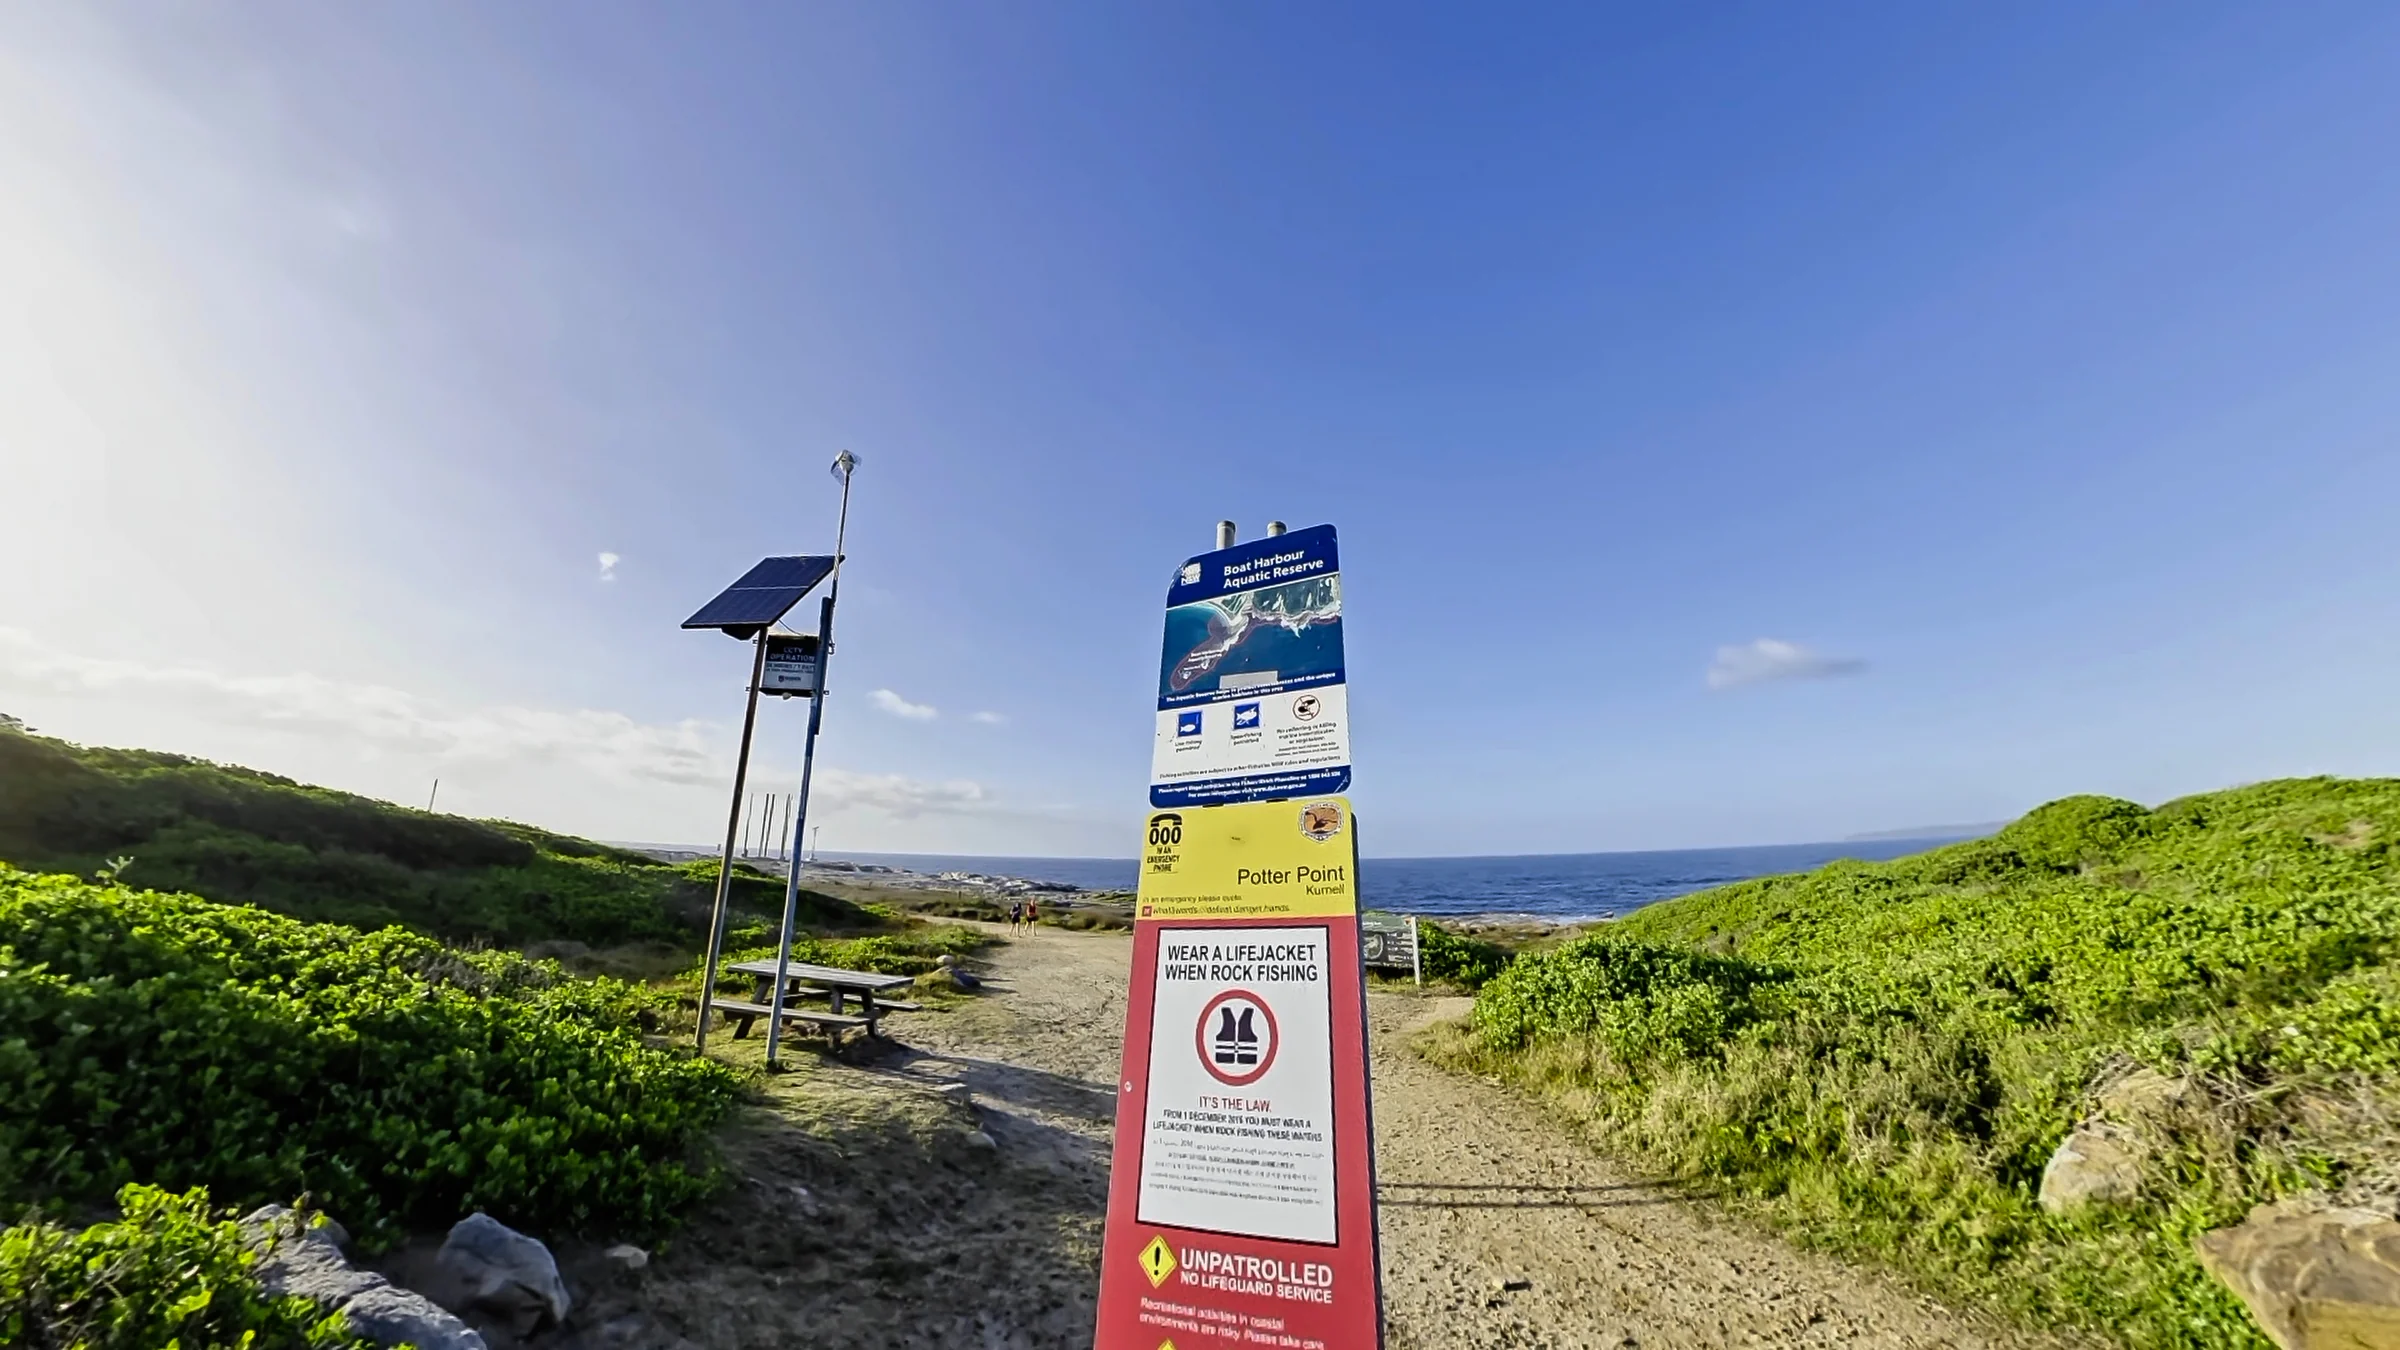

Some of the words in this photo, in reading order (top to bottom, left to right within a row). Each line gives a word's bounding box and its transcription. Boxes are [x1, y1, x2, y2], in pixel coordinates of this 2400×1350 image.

[1223, 561, 1251, 577] Boat
[1254, 550, 1305, 569] Harbour
[1181, 575, 1201, 586] NSW
[1223, 568, 1271, 589] Aquatic
[1273, 559, 1324, 578] Reserve
[770, 653, 815, 662] OPERATION
[1176, 694, 1195, 702] Aquatic
[1208, 767, 1226, 775] subject
[1149, 826, 1181, 846] 000
[1147, 854, 1180, 864] EMERGENCY
[1157, 846, 1163, 854] IN
[1163, 846, 1172, 854] AN
[1153, 863, 1172, 872] PHONE
[1238, 868, 1291, 885] Potter
[1297, 865, 1344, 883] Point
[1306, 884, 1344, 896] Kurnell
[1161, 896, 1196, 904] emergency
[1167, 945, 1209, 962] WEAR
[1212, 945, 1222, 962] A
[1226, 944, 1316, 962] LIFEJACKET
[1165, 964, 1207, 981] WHEN
[1211, 964, 1253, 981] ROCK
[1257, 964, 1318, 982] FISHING
[1199, 1096, 1219, 1109] IT'S
[1222, 1097, 1243, 1111] THE
[1163, 1109, 1182, 1119] FROM
[1189, 1111, 1227, 1123] DECEMBER
[1245, 1116, 1260, 1126] YOU
[1261, 1117, 1280, 1127] MUST
[1283, 1118, 1304, 1128] WEAR
[1306, 1120, 1311, 1128] A
[1153, 1121, 1192, 1132] LIFEJACKET
[1194, 1124, 1214, 1134] WHEN
[1216, 1126, 1236, 1136] ROCK
[1237, 1127, 1266, 1139] FISHING
[1267, 1130, 1290, 1140] THESE
[1291, 1131, 1323, 1142] WATERS
[1181, 1248, 1333, 1288] UNPATROLLED
[1180, 1271, 1199, 1285] NO
[1201, 1274, 1273, 1296] LIFEGUARD
[1275, 1283, 1332, 1304] SERVICE
[1140, 1296, 1196, 1316] Recreational
[1197, 1308, 1236, 1324] activities
[1239, 1312, 1248, 1325] in
[1250, 1316, 1284, 1331] coastal
[1139, 1313, 1199, 1333] environments
[1201, 1324, 1216, 1335] are
[1244, 1328, 1276, 1345] Please
[1279, 1334, 1300, 1348] take
